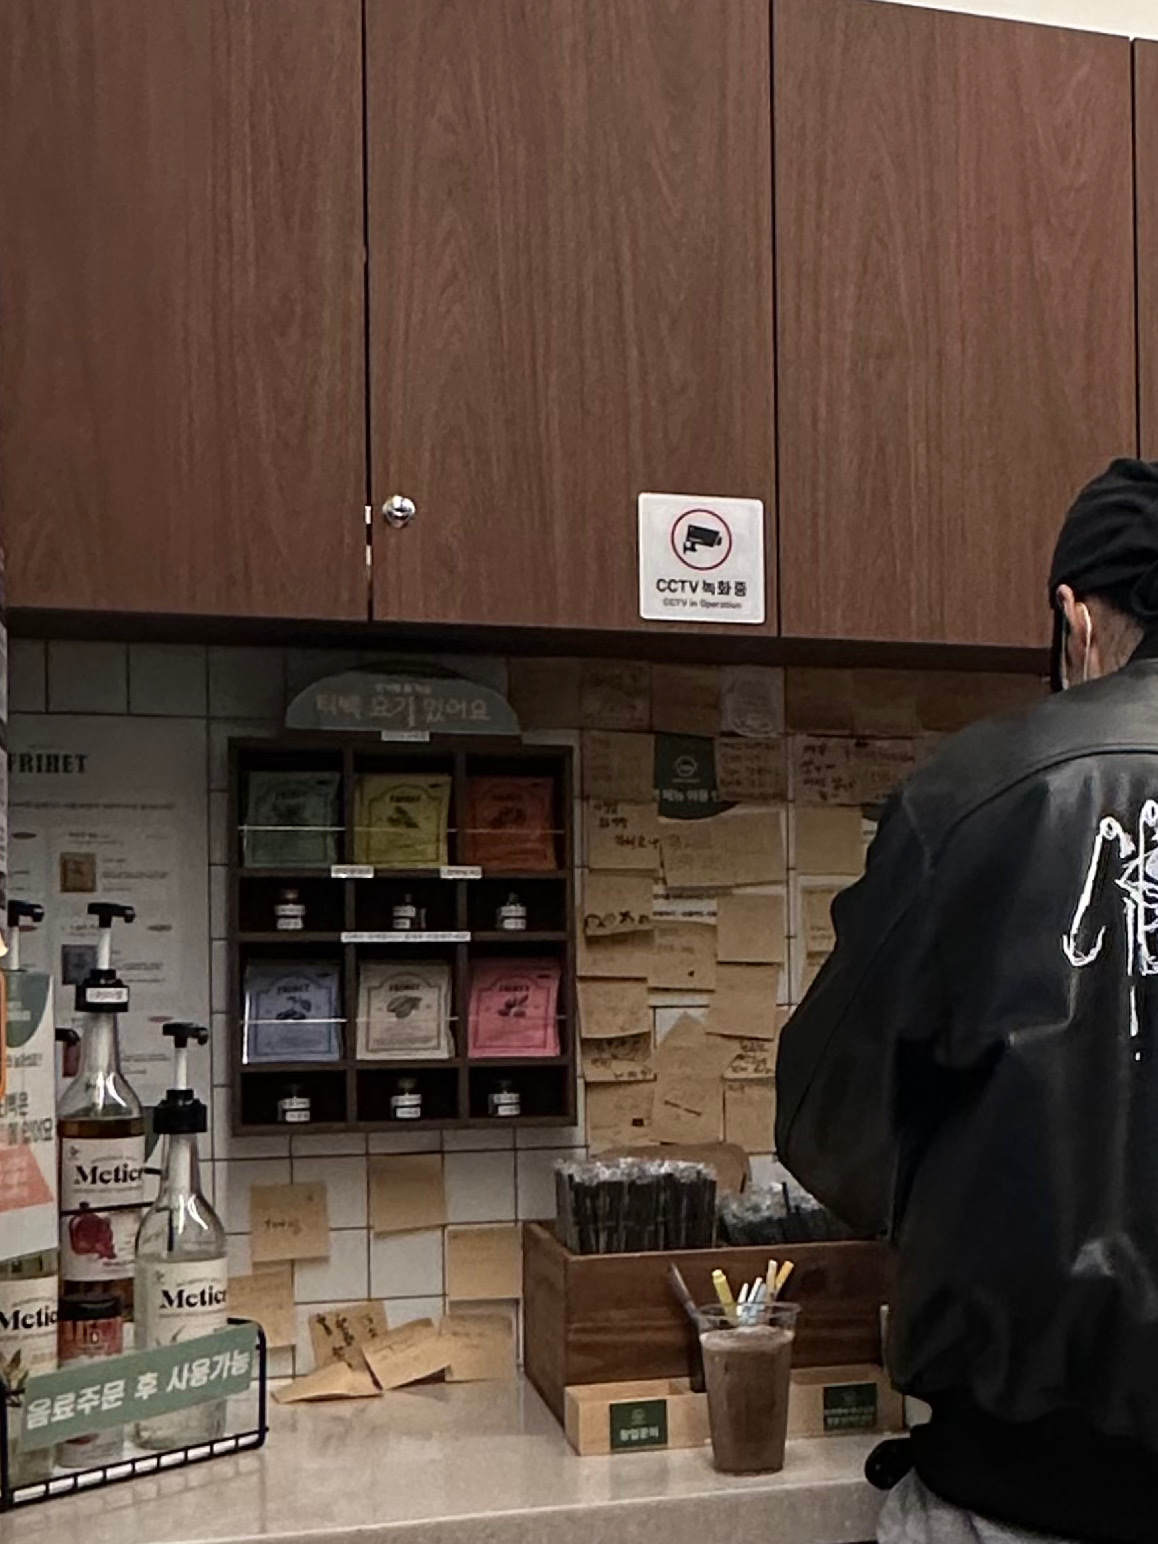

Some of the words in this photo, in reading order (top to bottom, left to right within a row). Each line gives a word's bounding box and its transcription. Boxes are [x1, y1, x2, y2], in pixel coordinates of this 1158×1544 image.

[656, 579, 699, 593] CCTV
[663, 598, 688, 607] CCTV
[689, 599, 698, 607] in
[700, 599, 742, 609] Operation
[8, 753, 89, 774] FRIHET
[26, 1380, 126, 1430] 음료주문
[134, 1373, 158, 1400] 후
[166, 1350, 250, 1393] 사용가능
